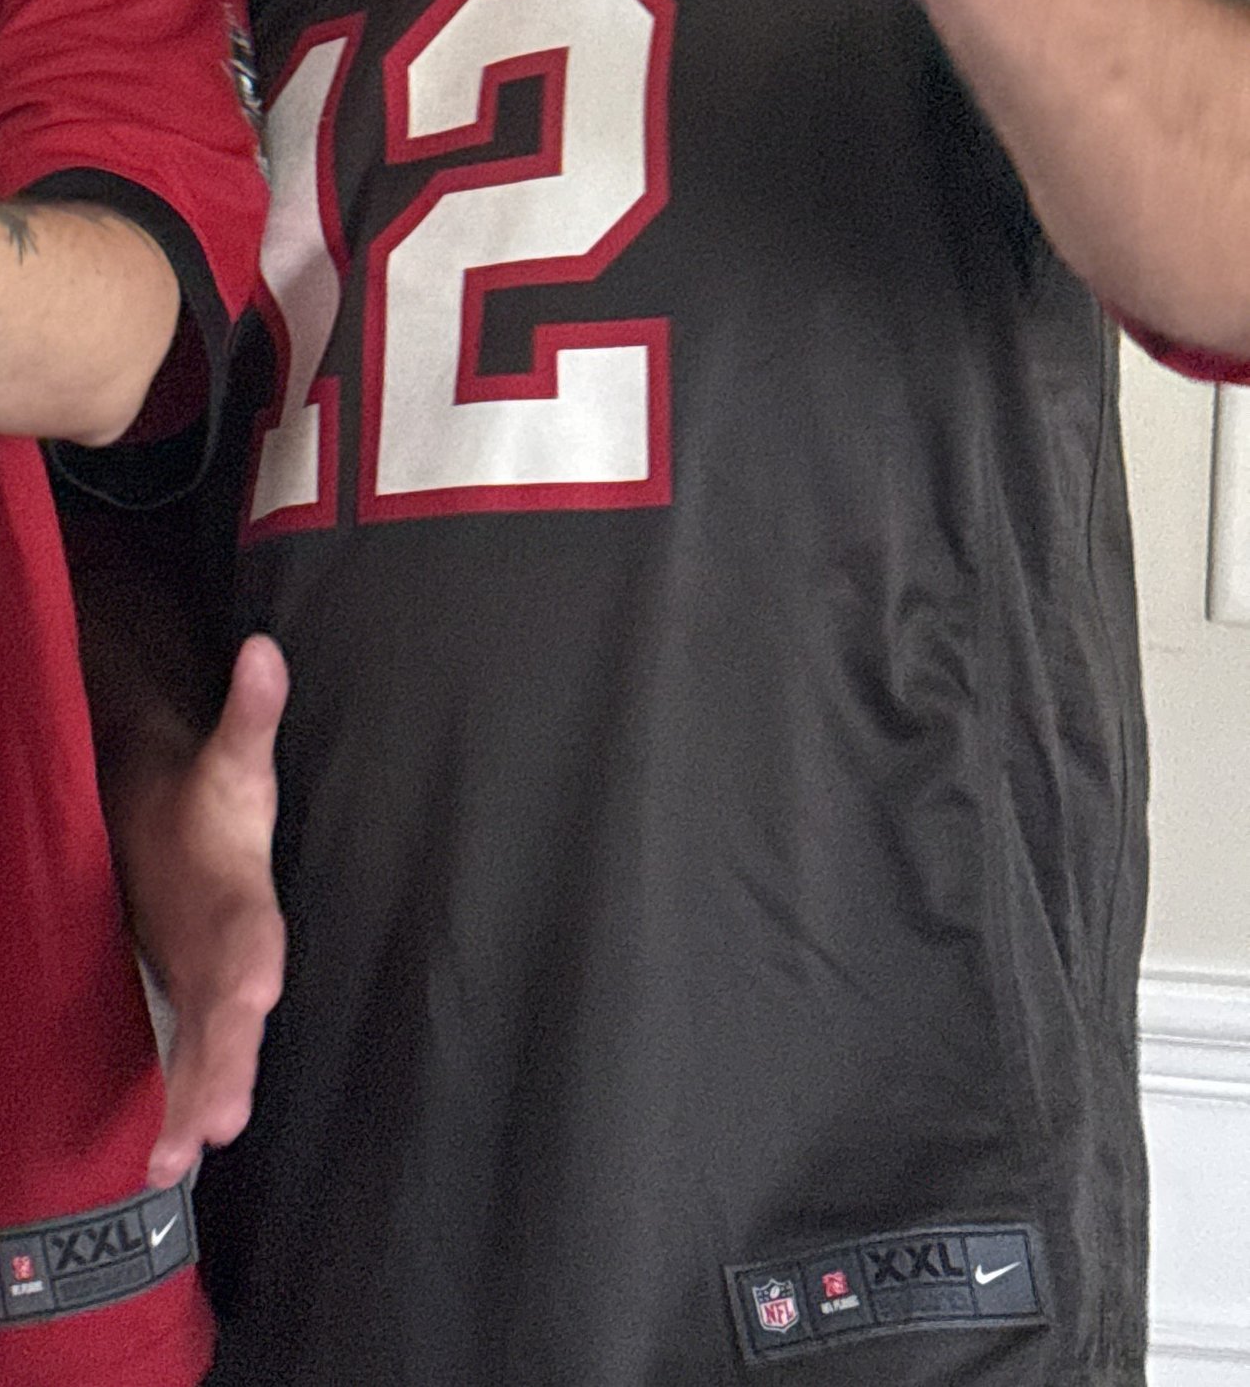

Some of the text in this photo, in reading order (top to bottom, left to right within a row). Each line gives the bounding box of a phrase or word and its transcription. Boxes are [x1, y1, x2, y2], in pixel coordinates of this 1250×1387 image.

[52, 1216, 143, 1271] XXL
[866, 1242, 964, 1283] XXL
[763, 1300, 795, 1325] NFL
